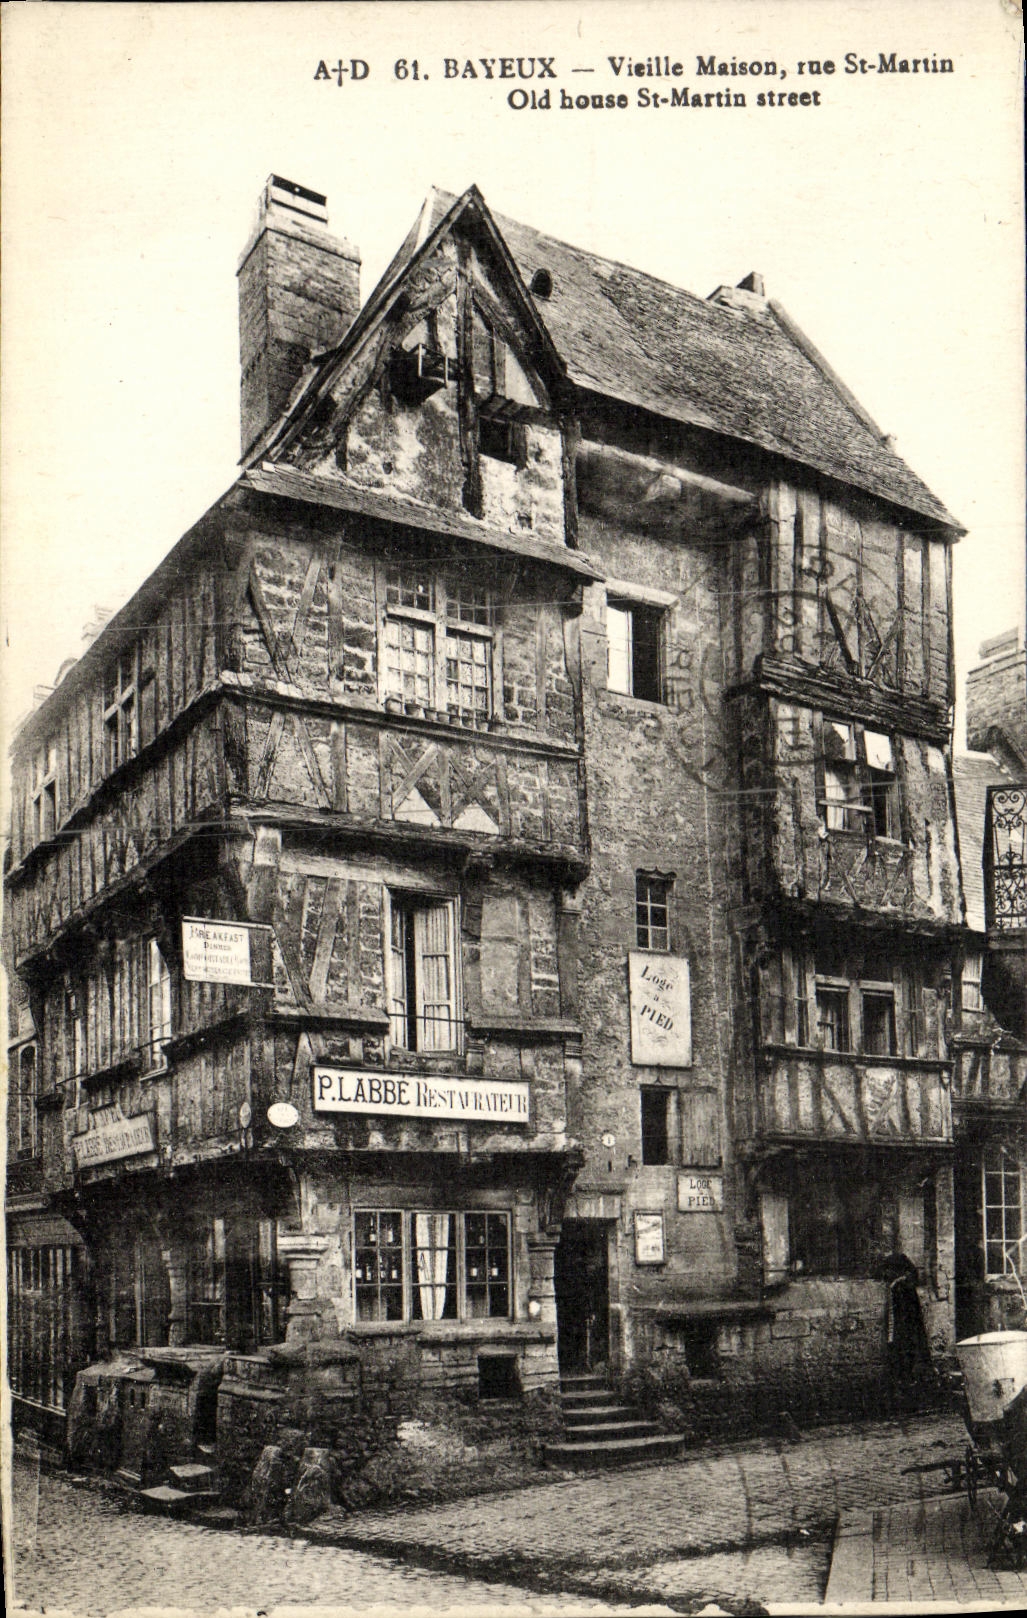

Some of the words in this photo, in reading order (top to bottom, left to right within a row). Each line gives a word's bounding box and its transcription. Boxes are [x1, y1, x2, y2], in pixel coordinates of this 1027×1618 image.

[640, 1004, 674, 1031] PIED
[416, 1081, 528, 1114] RESTAURATEUR
[688, 1196, 716, 1207] PIED
